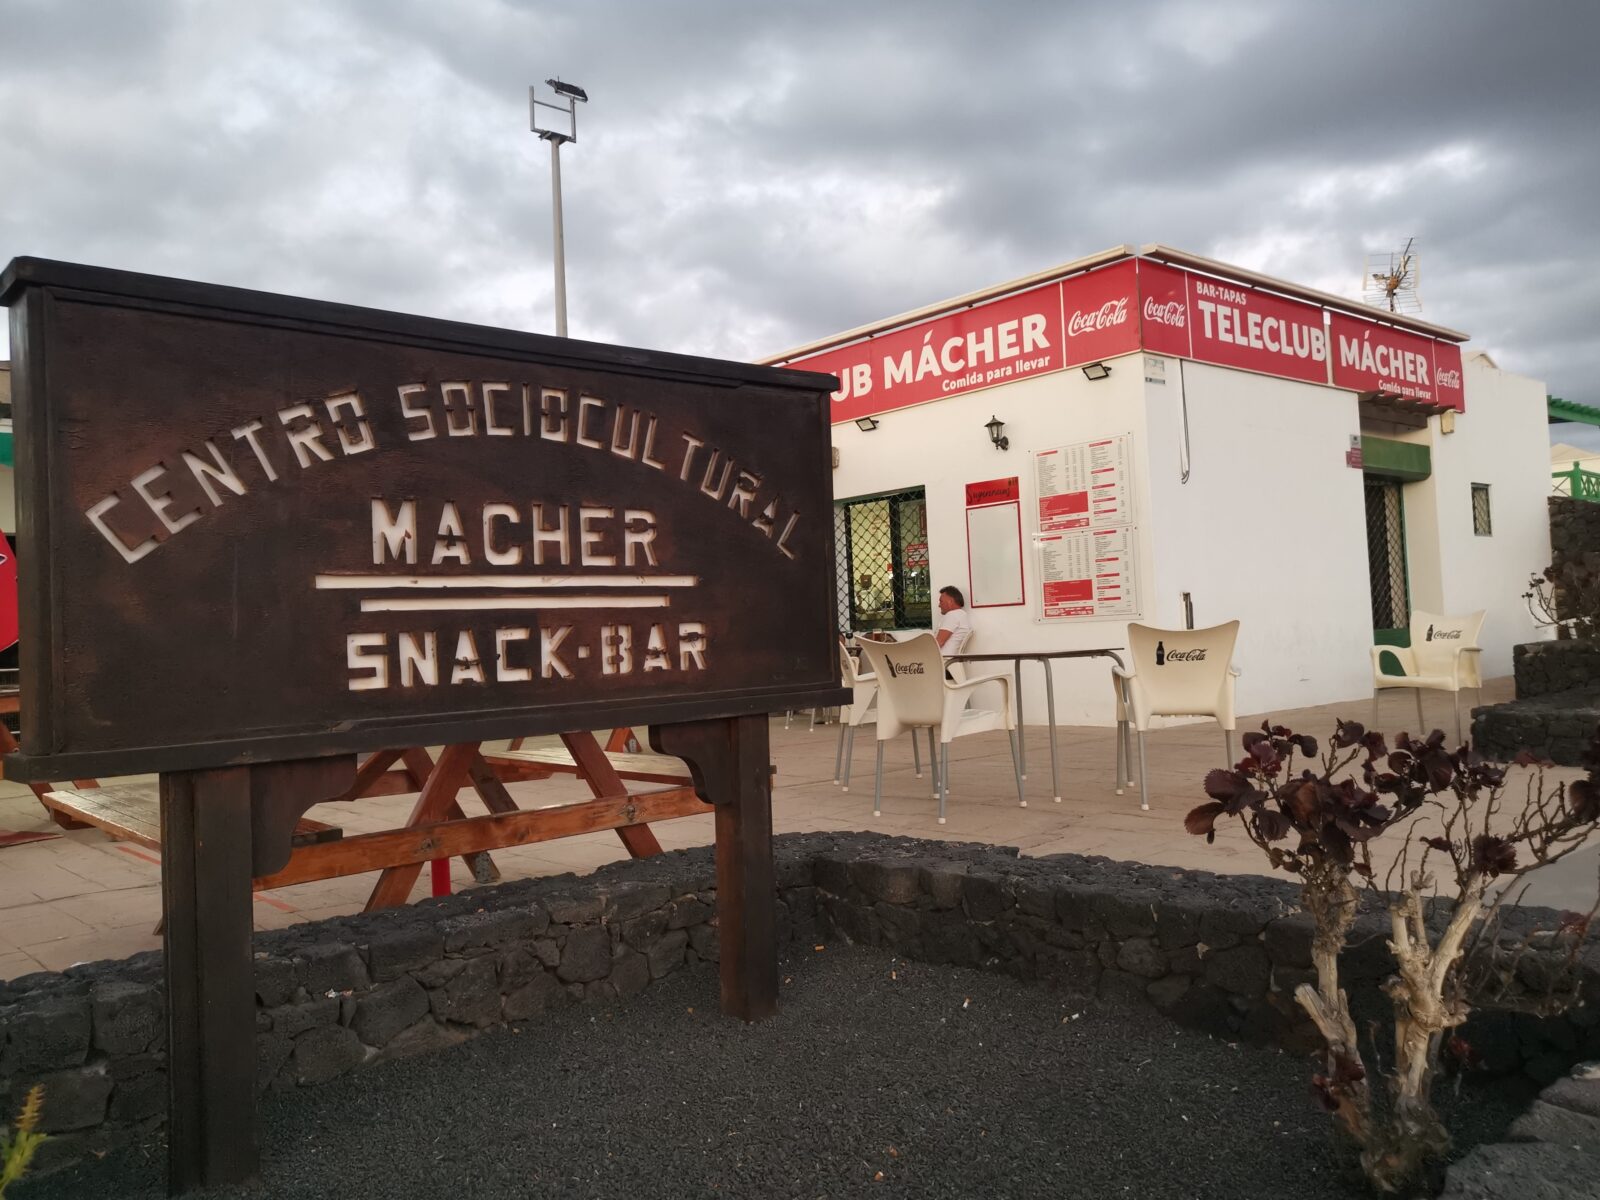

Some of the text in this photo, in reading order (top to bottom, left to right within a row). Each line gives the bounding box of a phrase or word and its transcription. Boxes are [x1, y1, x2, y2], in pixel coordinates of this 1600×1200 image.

[1196, 281, 1247, 305] BAR-TAPAS
[883, 313, 1051, 390] MÁCHER
[942, 355, 1051, 392] Comida para llevar
[1198, 299, 1430, 386] TELECLUB MÁCHER
[1378, 379, 1401, 394] Comida
[1415, 387, 1432, 400] llevar
[84, 380, 802, 564] CENTRO SOCIOCULTURAL
[370, 498, 659, 569] MACHER
